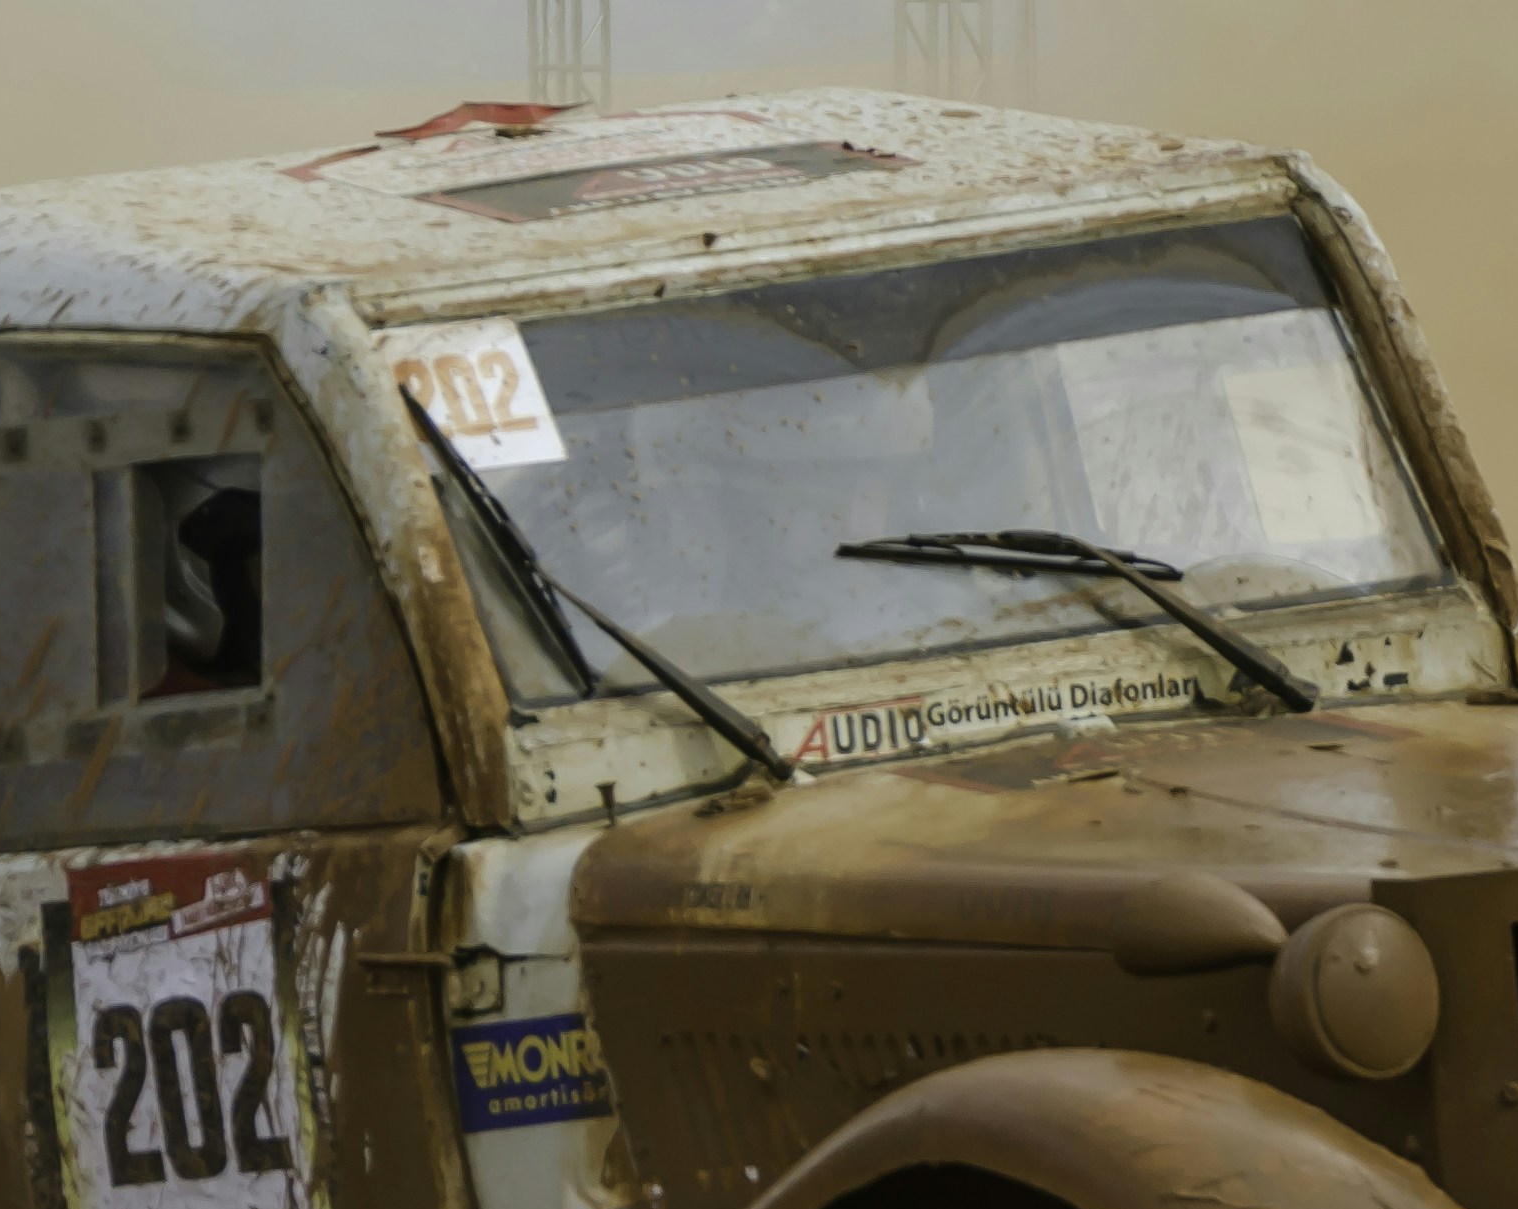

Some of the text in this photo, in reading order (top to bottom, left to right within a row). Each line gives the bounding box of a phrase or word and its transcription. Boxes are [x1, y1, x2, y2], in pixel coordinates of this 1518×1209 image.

[393, 349, 538, 442] 202
[791, 708, 925, 764] AUDIO
[927, 687, 1062, 727] Görüntülü
[92, 990, 293, 1188] 202
[487, 1030, 601, 1087] MONR
